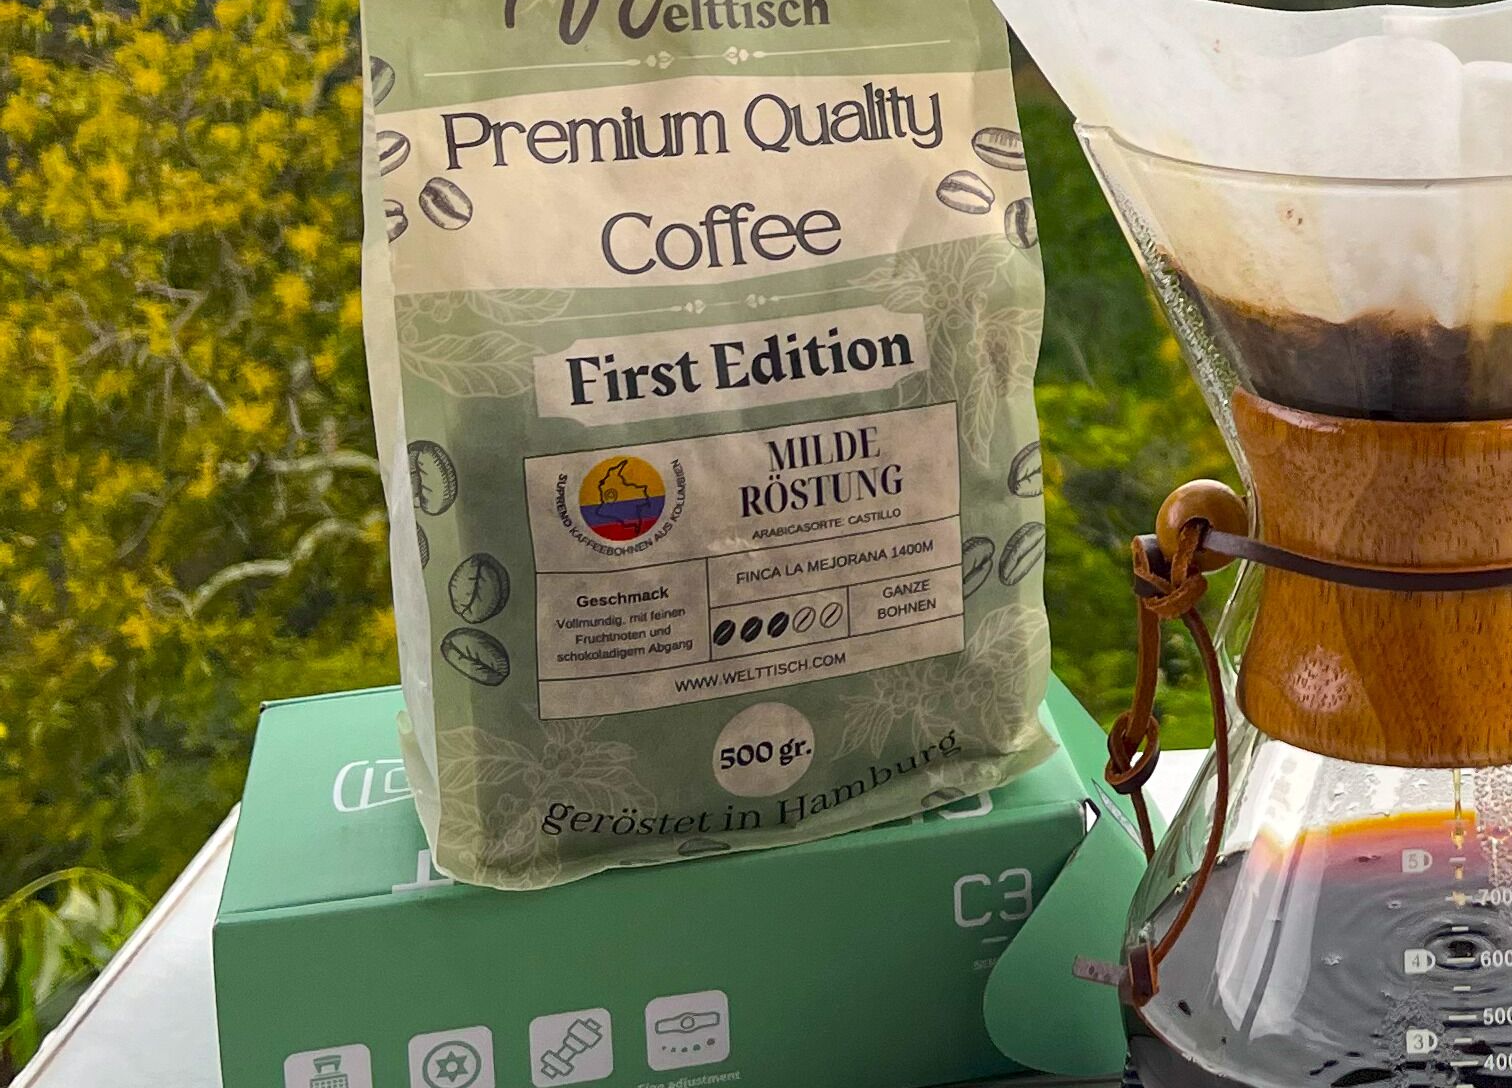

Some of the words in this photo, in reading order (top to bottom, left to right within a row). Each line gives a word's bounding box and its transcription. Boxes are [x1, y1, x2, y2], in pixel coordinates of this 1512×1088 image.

[440, 105, 727, 172] Premium
[744, 82, 944, 151] Quality
[601, 203, 843, 276] Coffee
[566, 350, 701, 406] First
[710, 327, 914, 391] Edition
[766, 426, 881, 472] MILDE
[569, 526, 653, 556] KAFFEEBOHNEN
[654, 521, 673, 543] AUS
[670, 458, 686, 522] KOLUMBIEN
[738, 463, 904, 518] RÖSTUNG
[848, 508, 901, 525] CASTILLO
[736, 563, 782, 584] FINCA
[785, 561, 803, 576] LA
[807, 548, 888, 573] MEJORANA
[891, 540, 934, 559] 1400M
[576, 586, 669, 608] Geschmack
[882, 579, 931, 599] GANZE
[629, 613, 648, 624] mit
[650, 607, 686, 621] feinen
[877, 598, 937, 620] BOHNEN
[557, 645, 645, 663] schokoladigem
[648, 639, 693, 655] Abgang
[575, 629, 646, 645] Fruchtnoten
[649, 624, 672, 637] und
[674, 652, 847, 693] WWW.WELTTISCH.COM
[720, 741, 774, 770] 500
[779, 738, 812, 766] gr.
[541, 802, 712, 836] geröstet
[723, 804, 762, 833] in
[777, 729, 962, 825] Hamburg
[953, 868, 1033, 927] C3
[1413, 1034, 1423, 1050] 3
[668, 1072, 741, 1088] adjustment
